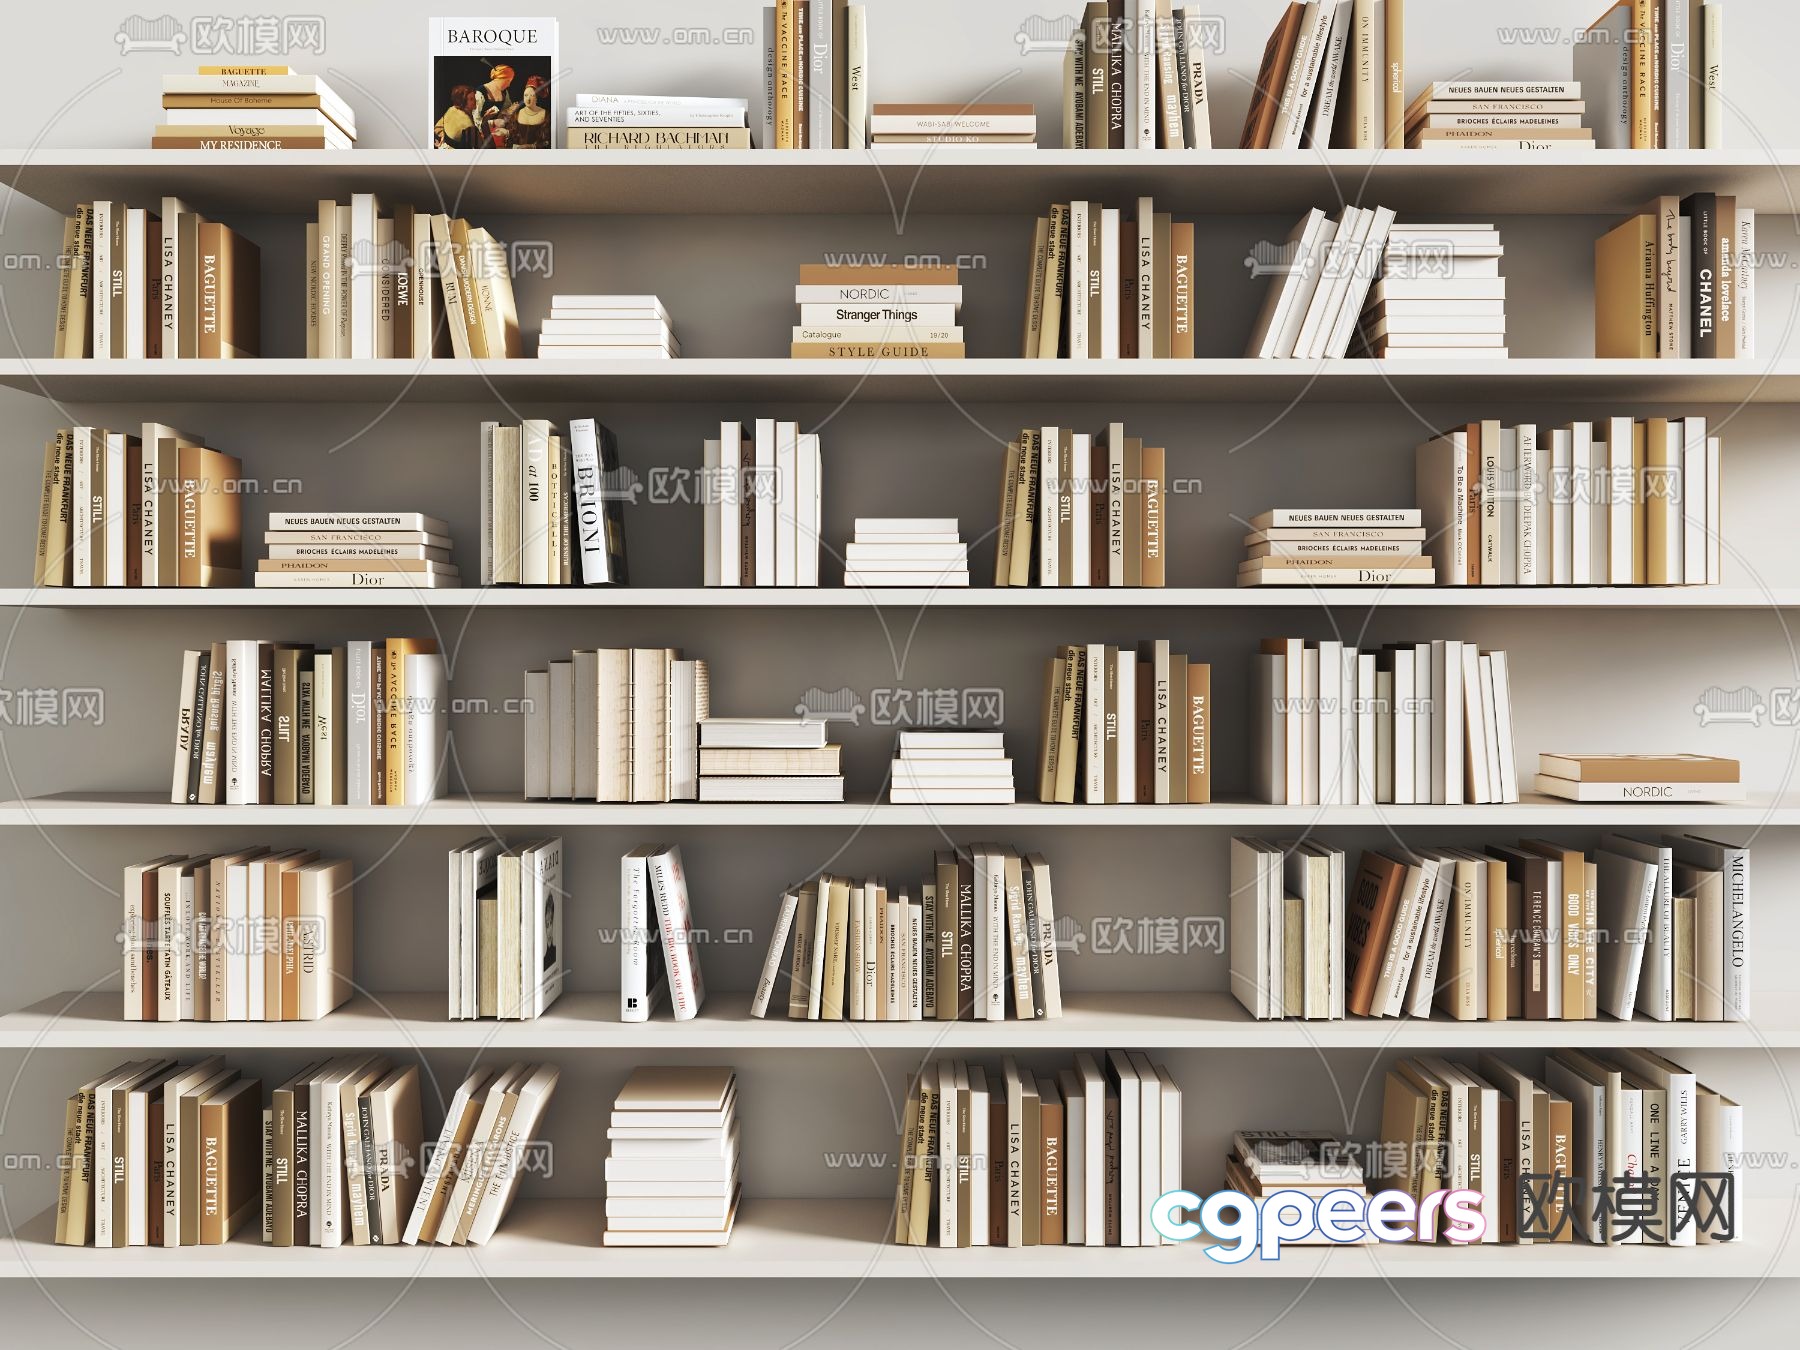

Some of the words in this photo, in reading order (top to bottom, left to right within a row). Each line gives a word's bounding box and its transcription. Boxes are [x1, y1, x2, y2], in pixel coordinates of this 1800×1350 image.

[448, 28, 537, 47] BAROQUE
[812, 43, 829, 75] Dior
[1300, 88, 1309, 98] for
[1306, 43, 1321, 81] sustainable
[1315, 14, 1328, 41] lifestyle
[222, 80, 260, 88] MAGAZINE
[851, 66, 862, 91] West
[1193, 62, 1204, 105] PRADA
[1391, 62, 1402, 93] spherical
[1449, 86, 1472, 94] NEUES
[1474, 86, 1498, 94] BAUEN
[1501, 86, 1523, 94] NEUES
[1526, 86, 1565, 94] GESTALTEN
[228, 125, 265, 137] Voyage
[584, 129, 650, 143] RICHARD
[656, 129, 729, 143] BACHMAN
[200, 140, 218, 150] MY
[221, 140, 281, 150] RESIDENCE
[1050, 207, 1059, 218] die
[1060, 208, 1070, 225] DAS
[1049, 221, 1058, 239] neue
[1058, 228, 1068, 249] NEUE
[163, 237, 173, 267] LISA
[322, 236, 331, 268] GRAND
[1048, 241, 1057, 260] stadt
[1141, 237, 1151, 267] LISA
[1645, 241, 1655, 279] Arianna
[1722, 238, 1732, 277] amanda
[112, 270, 123, 298] STILL
[1055, 251, 1066, 299] FRANKFURT
[1090, 270, 1100, 298] STILL
[203, 255, 216, 334] BAGUETTE
[322, 272, 331, 315] OPENING
[382, 259, 390, 321] CONSIDERED
[398, 272, 408, 306] LOEWE
[445, 282, 457, 305] RUM
[840, 288, 889, 299] NORDIC
[1176, 255, 1188, 334] BAGUETTE
[1722, 281, 1732, 322] lovelace
[163, 274, 173, 331] CHANEY
[837, 309, 880, 322] Stranger
[882, 309, 918, 322] Things
[1141, 274, 1151, 331] CHANEY
[1642, 283, 1656, 336] Huffington
[1700, 269, 1712, 338] CHANEL
[802, 330, 842, 341] Catalogue
[829, 347, 875, 358] STYLE
[882, 347, 929, 358] GUIDE
[144, 463, 153, 493] LISA
[529, 465, 539, 478] at
[1456, 466, 1464, 474] To
[1456, 477, 1464, 486] Be
[529, 482, 539, 502] 100
[184, 480, 196, 558] BAGUETTE
[285, 518, 308, 526] NEUES
[311, 518, 334, 526] BAUEN
[337, 518, 360, 526] NEUES
[362, 518, 401, 526] GESTALTEN
[577, 467, 601, 555] BRIONI
[1456, 496, 1464, 525] Machine
[144, 500, 153, 556] CHANEY
[1298, 544, 1329, 552] BRIOCHES
[1361, 544, 1399, 552] MADELEINES
[352, 572, 385, 586] Dior
[1358, 569, 1392, 583] Dior
[1158, 680, 1167, 710] LISA
[1107, 713, 1117, 741] STILL
[1192, 696, 1205, 774] BAGUETTE
[1158, 717, 1167, 773] CHANEY
[1623, 786, 1673, 798] NORDIC
[632, 868, 640, 886] The
[654, 865, 667, 891] MILES
[1464, 882, 1472, 894] ON
[659, 893, 670, 917] REDD
[960, 884, 971, 937] MALLIKA
[1567, 894, 1580, 916] GOOD
[1731, 856, 1744, 968] MICHELANGELO
[664, 919, 673, 936] THE
[1464, 899, 1472, 950] IMMUNITY
[1567, 923, 1580, 948] VIBES
[632, 940, 640, 966] Room
[668, 938, 677, 952] BIG
[942, 931, 952, 958] STILL
[670, 954, 682, 977] BOOK
[866, 960, 876, 987] Dior
[960, 944, 971, 992] CHOPRA
[1567, 954, 1580, 975] ONLY
[675, 980, 683, 989] OF
[758, 977, 771, 1003] Beauty
[1015, 957, 1031, 999] mayhem
[678, 990, 688, 1013] CHIC
[78, 1092, 86, 1103] die
[1651, 1103, 1660, 1124] ONE
[75, 1125, 83, 1144] stadt
[296, 1110, 307, 1163] MALLIKA
[1010, 1123, 1020, 1153] LISA
[1651, 1132, 1660, 1158] LINE
[1046, 1137, 1058, 1216] BAGUETTE
[1470, 1154, 1481, 1182] STILL
[296, 1170, 307, 1218] CHOPRA
[489, 1183, 501, 1197] THE
[1010, 1161, 1020, 1216] CHANEY
